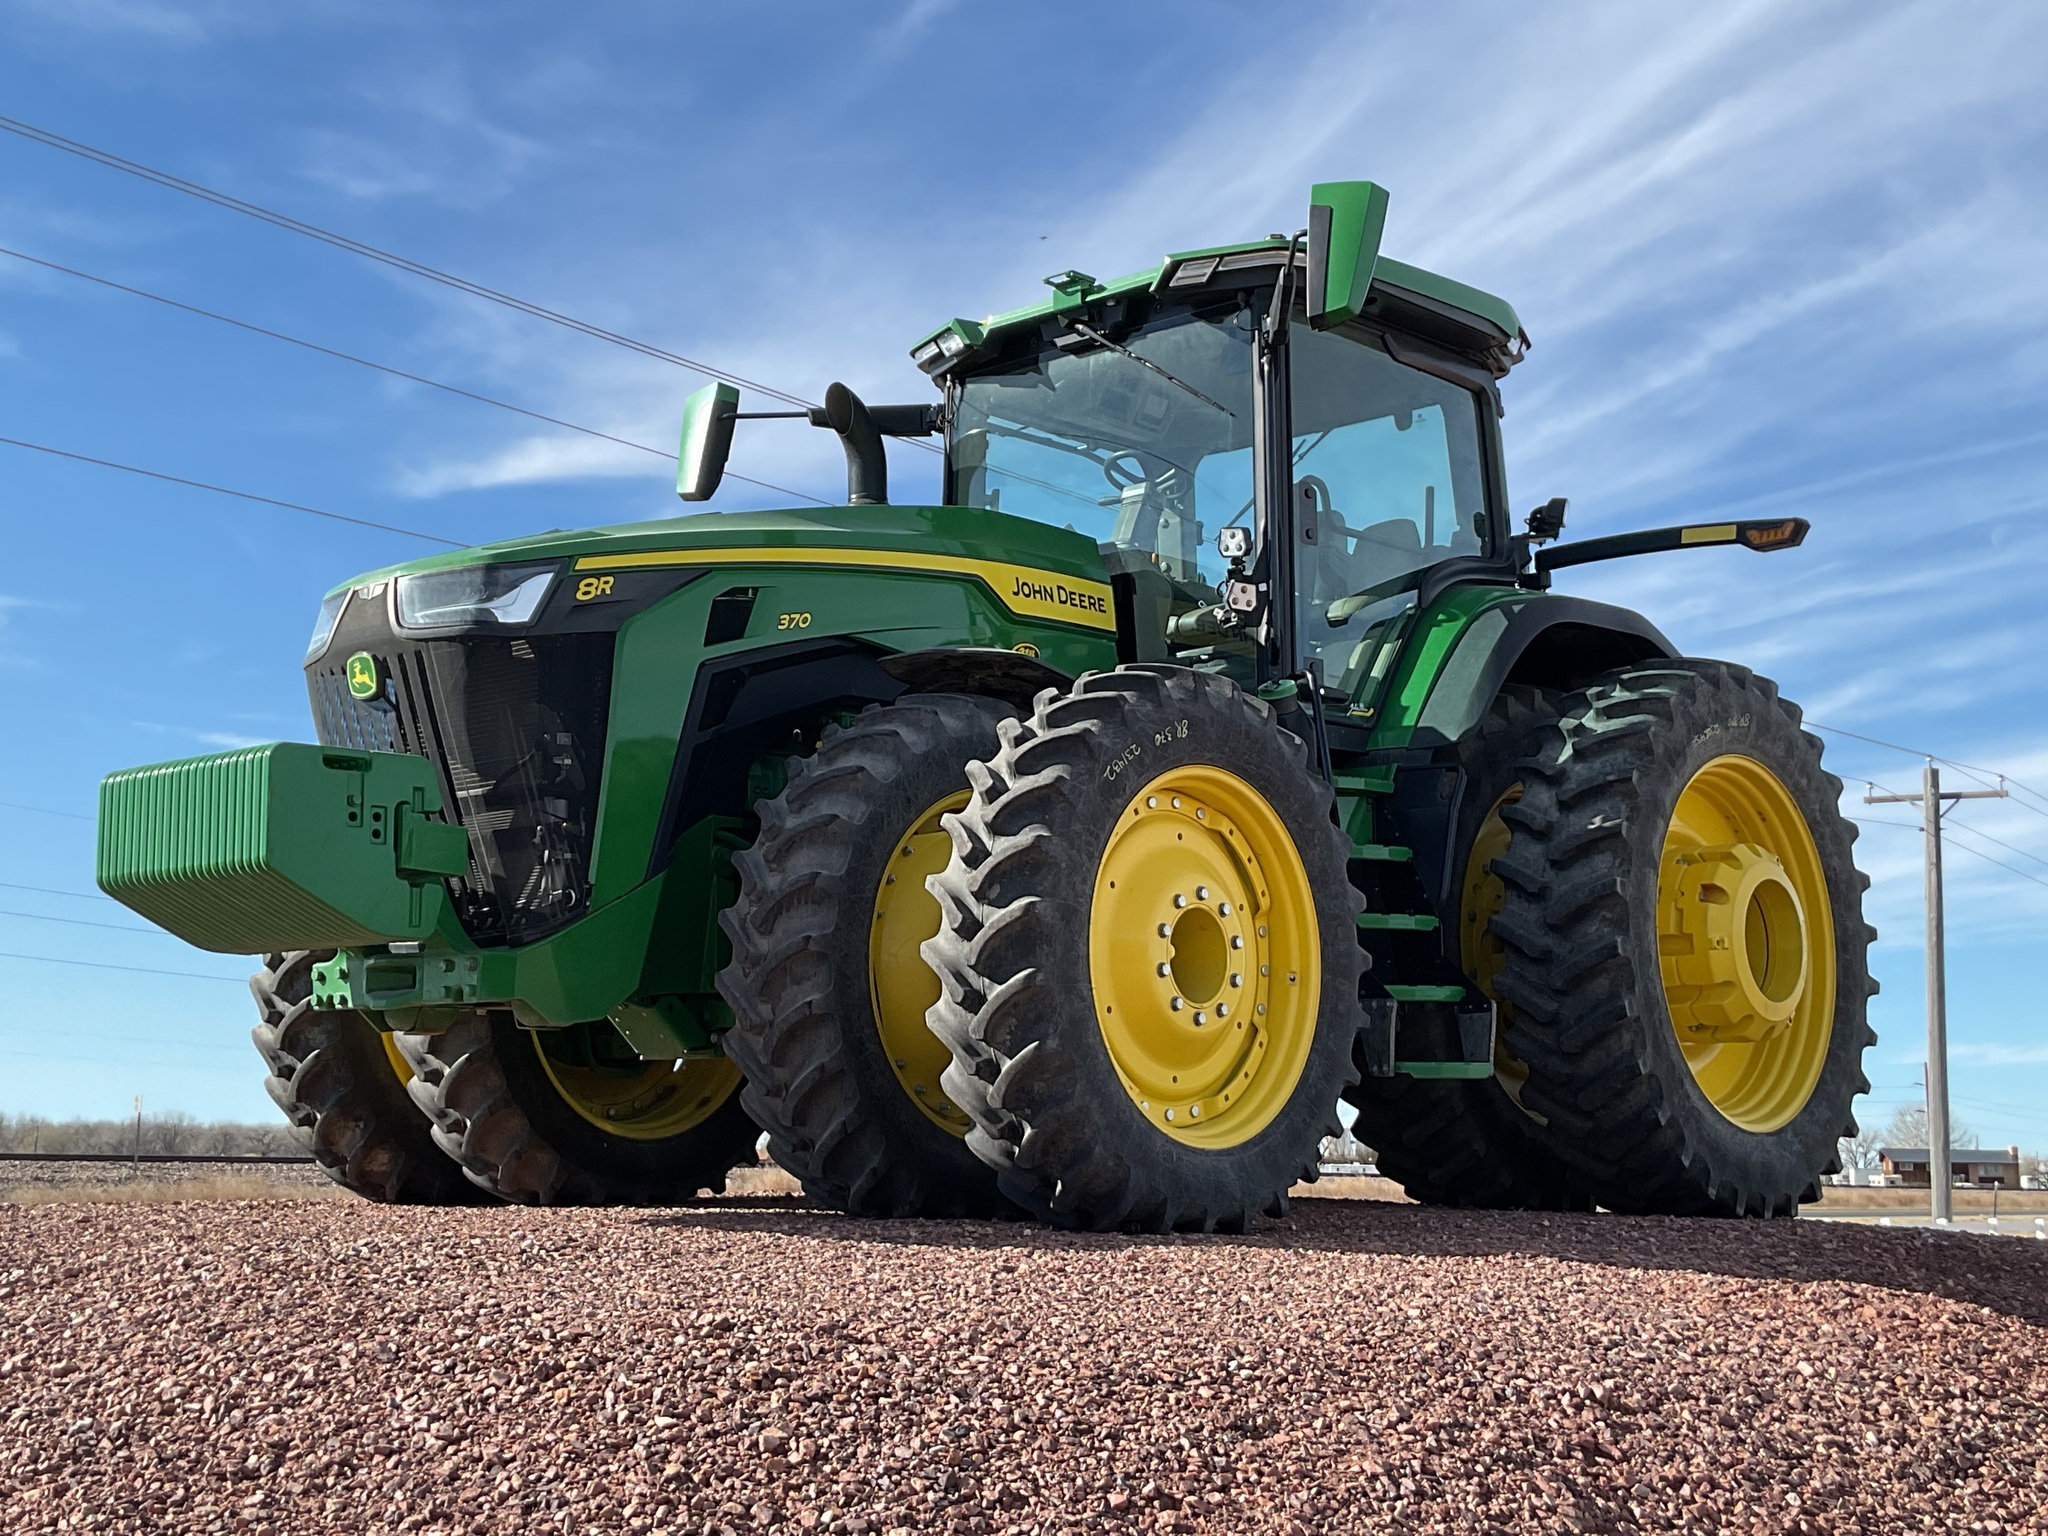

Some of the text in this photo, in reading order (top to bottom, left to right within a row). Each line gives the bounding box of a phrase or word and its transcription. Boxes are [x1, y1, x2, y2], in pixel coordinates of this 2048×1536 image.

[576, 575, 615, 601] 8R
[1012, 576, 1107, 614] JOHN DEERE
[777, 612, 812, 630] 370
[1154, 726, 1172, 746] 370
[1174, 719, 1188, 738] 8R
